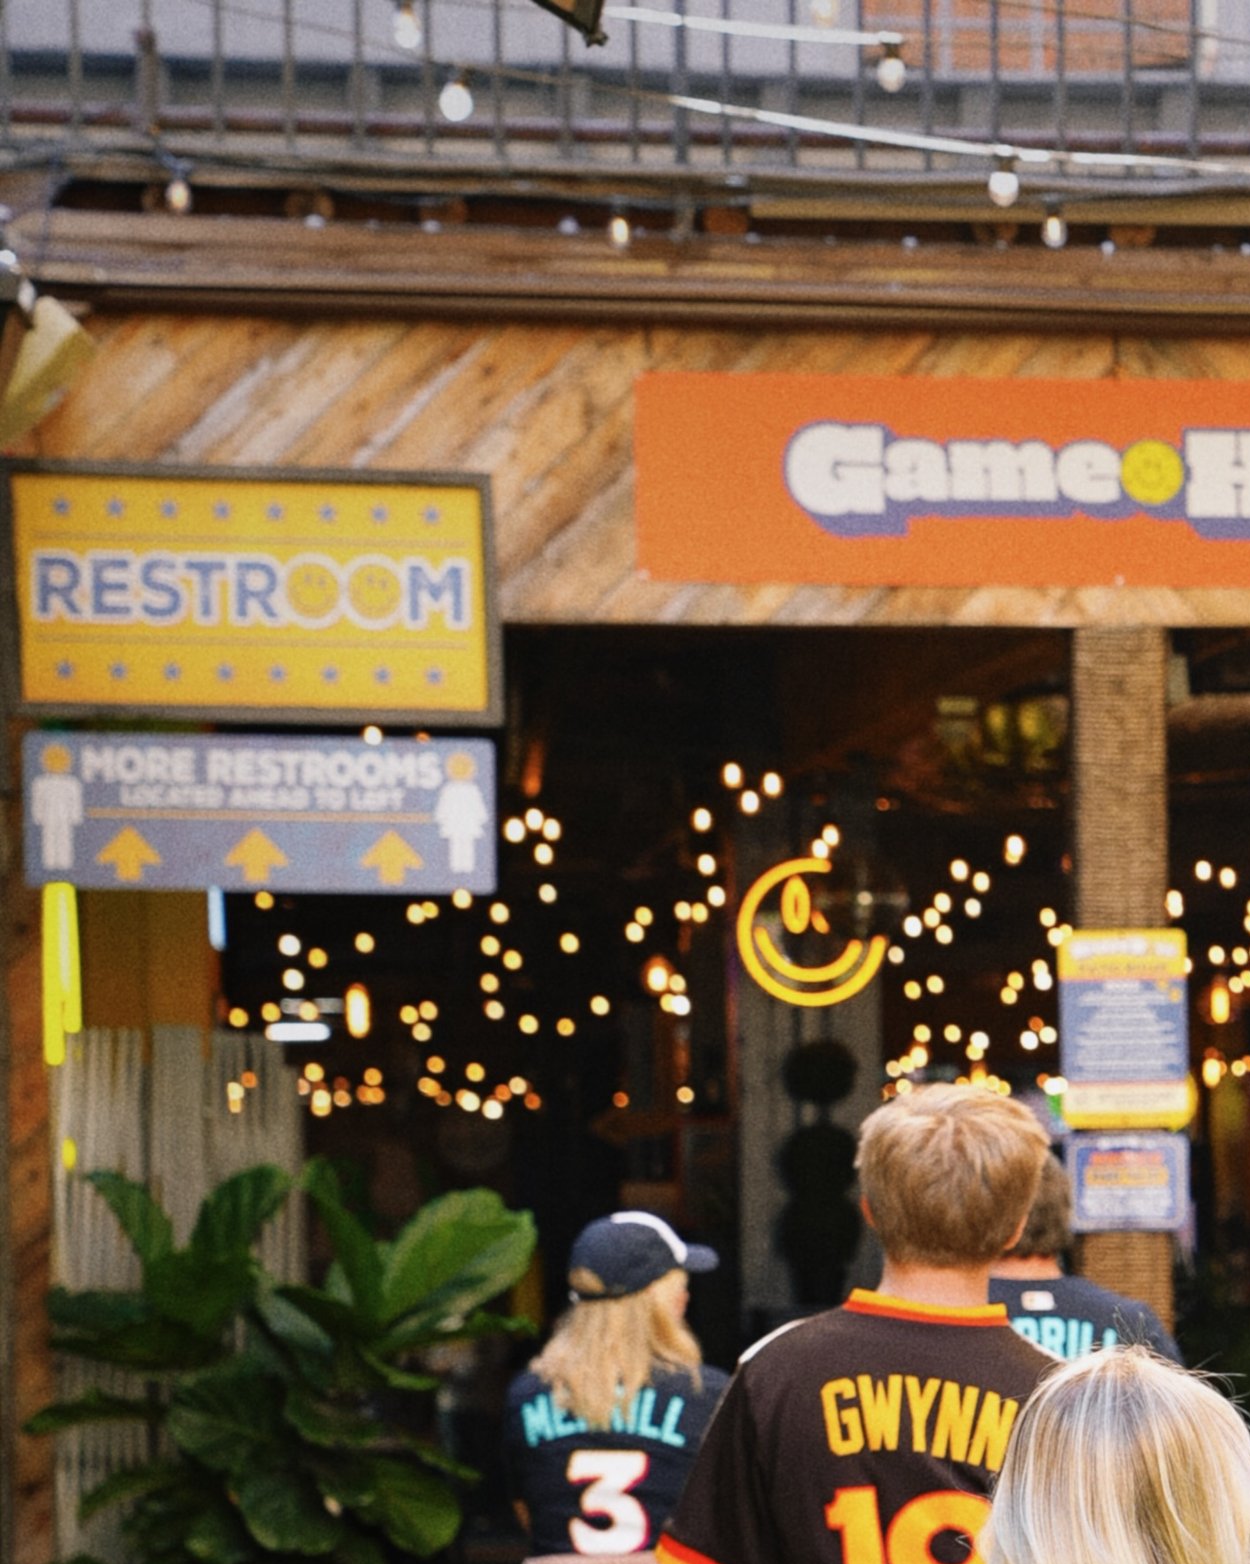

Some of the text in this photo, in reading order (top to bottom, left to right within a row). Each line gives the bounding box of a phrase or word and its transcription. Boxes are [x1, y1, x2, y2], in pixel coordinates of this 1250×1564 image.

[784, 420, 1122, 530] Game
[31, 548, 473, 632] RESTROOM
[81, 745, 444, 790] MORE RESTROOMS
[820, 1373, 1019, 1473] GWYNN
[566, 1448, 651, 1556] 3
